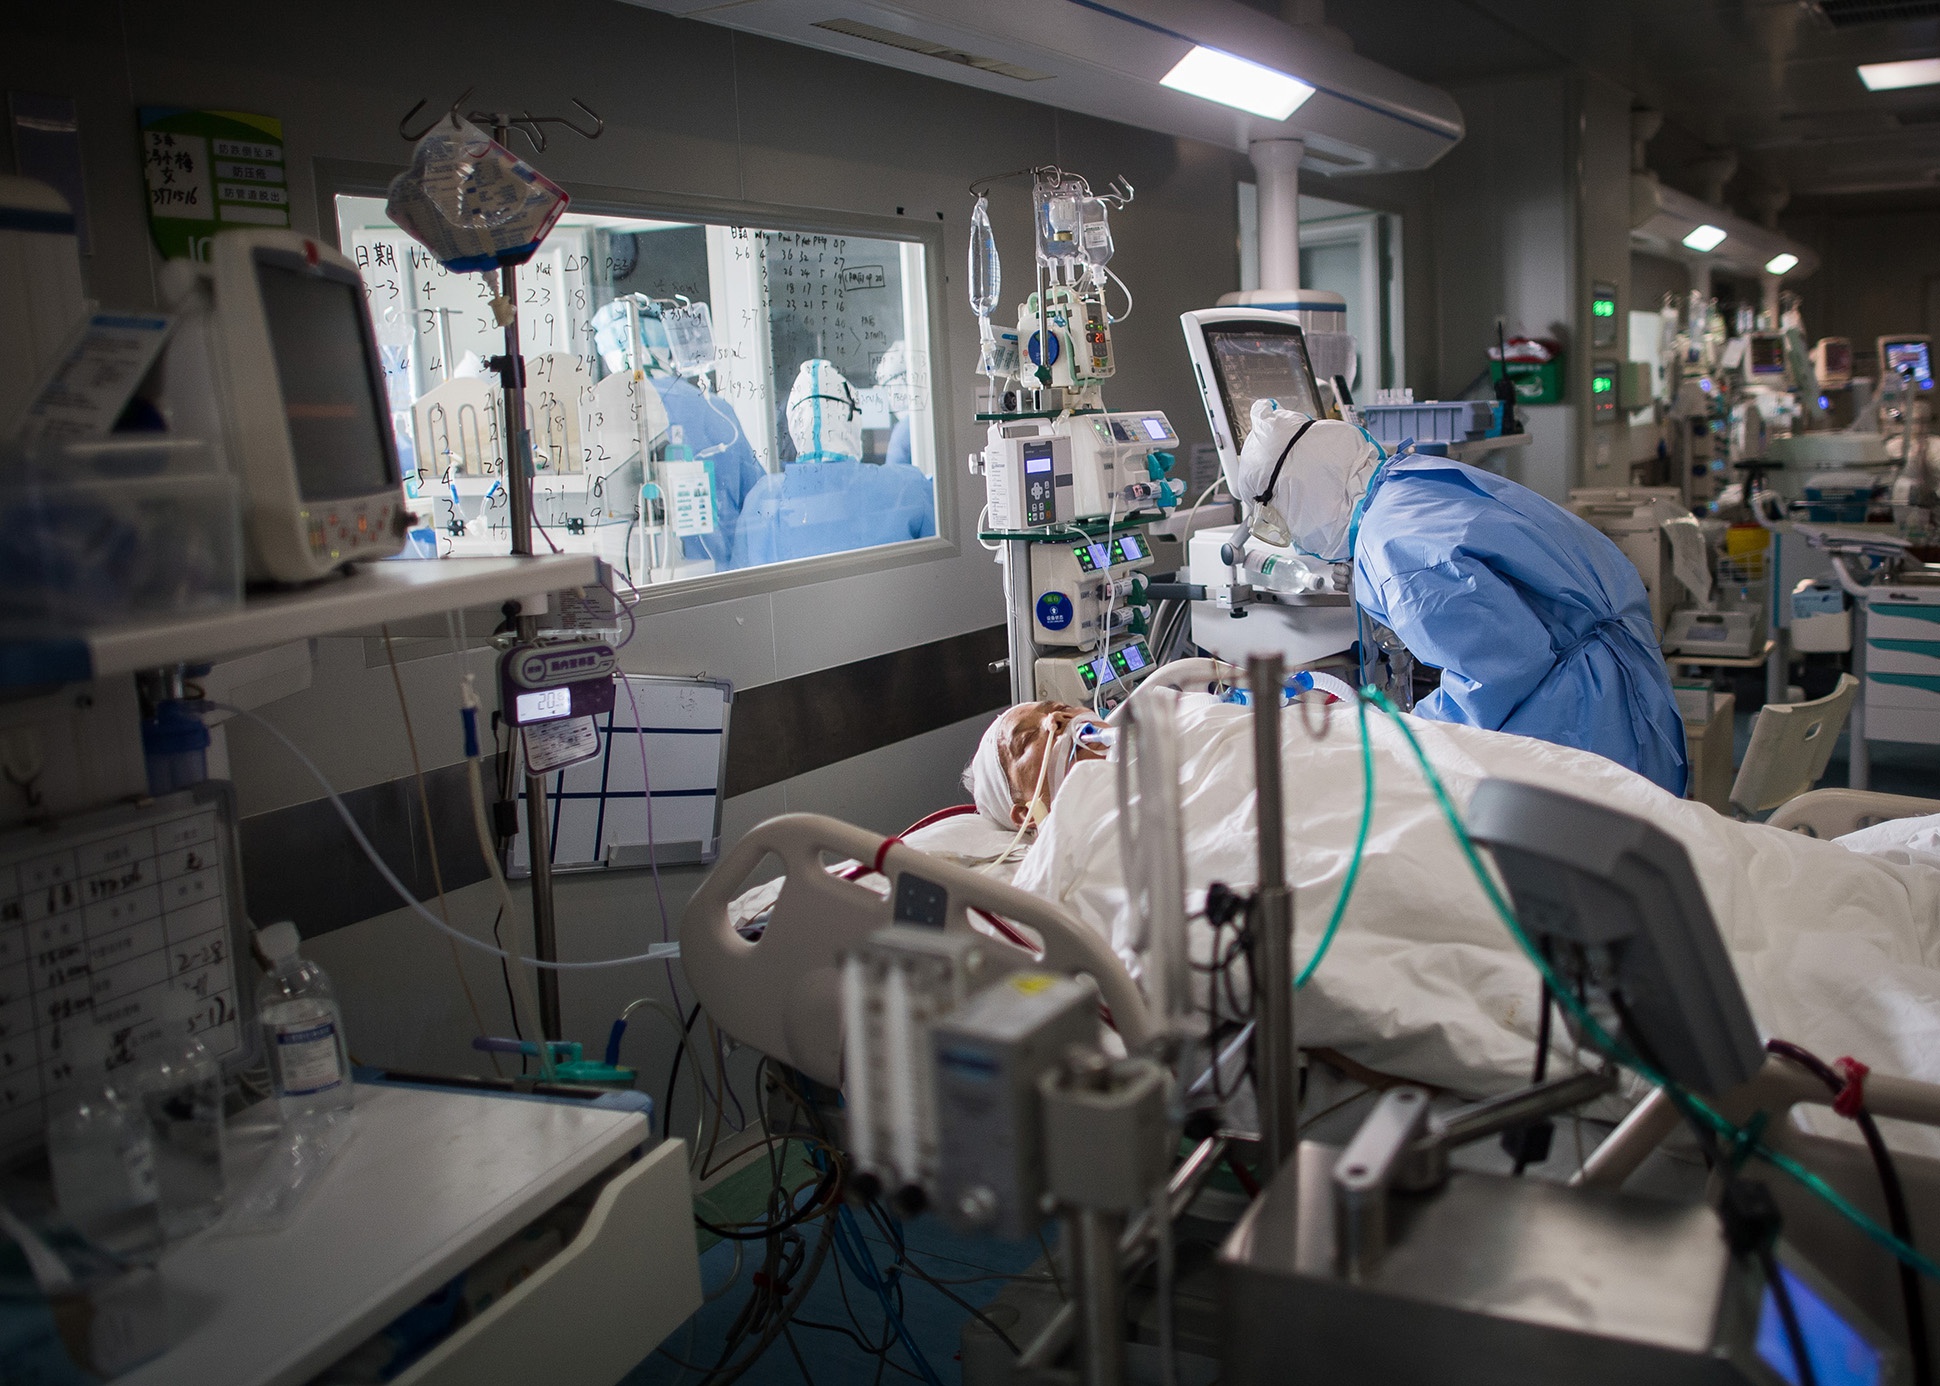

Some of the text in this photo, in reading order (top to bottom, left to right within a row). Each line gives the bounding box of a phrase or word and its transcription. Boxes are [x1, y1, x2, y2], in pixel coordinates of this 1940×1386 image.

[356, 244, 398, 273] 日期
[422, 281, 437, 300] 4
[524, 287, 552, 307] 23
[567, 288, 587, 310] 18
[423, 308, 436, 335] 3
[532, 313, 554, 347] 19
[572, 318, 596, 342] 14
[429, 355, 443, 371] 4
[537, 353, 554, 383] 29
[575, 354, 596, 377] 24
[432, 402, 444, 423] 3
[539, 391, 557, 410] 23
[626, 380, 638, 398] 5
[548, 412, 564, 434] 18
[586, 412, 604, 432] 13
[630, 403, 643, 422] 5
[538, 444, 562, 476] 27
[584, 444, 611, 463] 22
